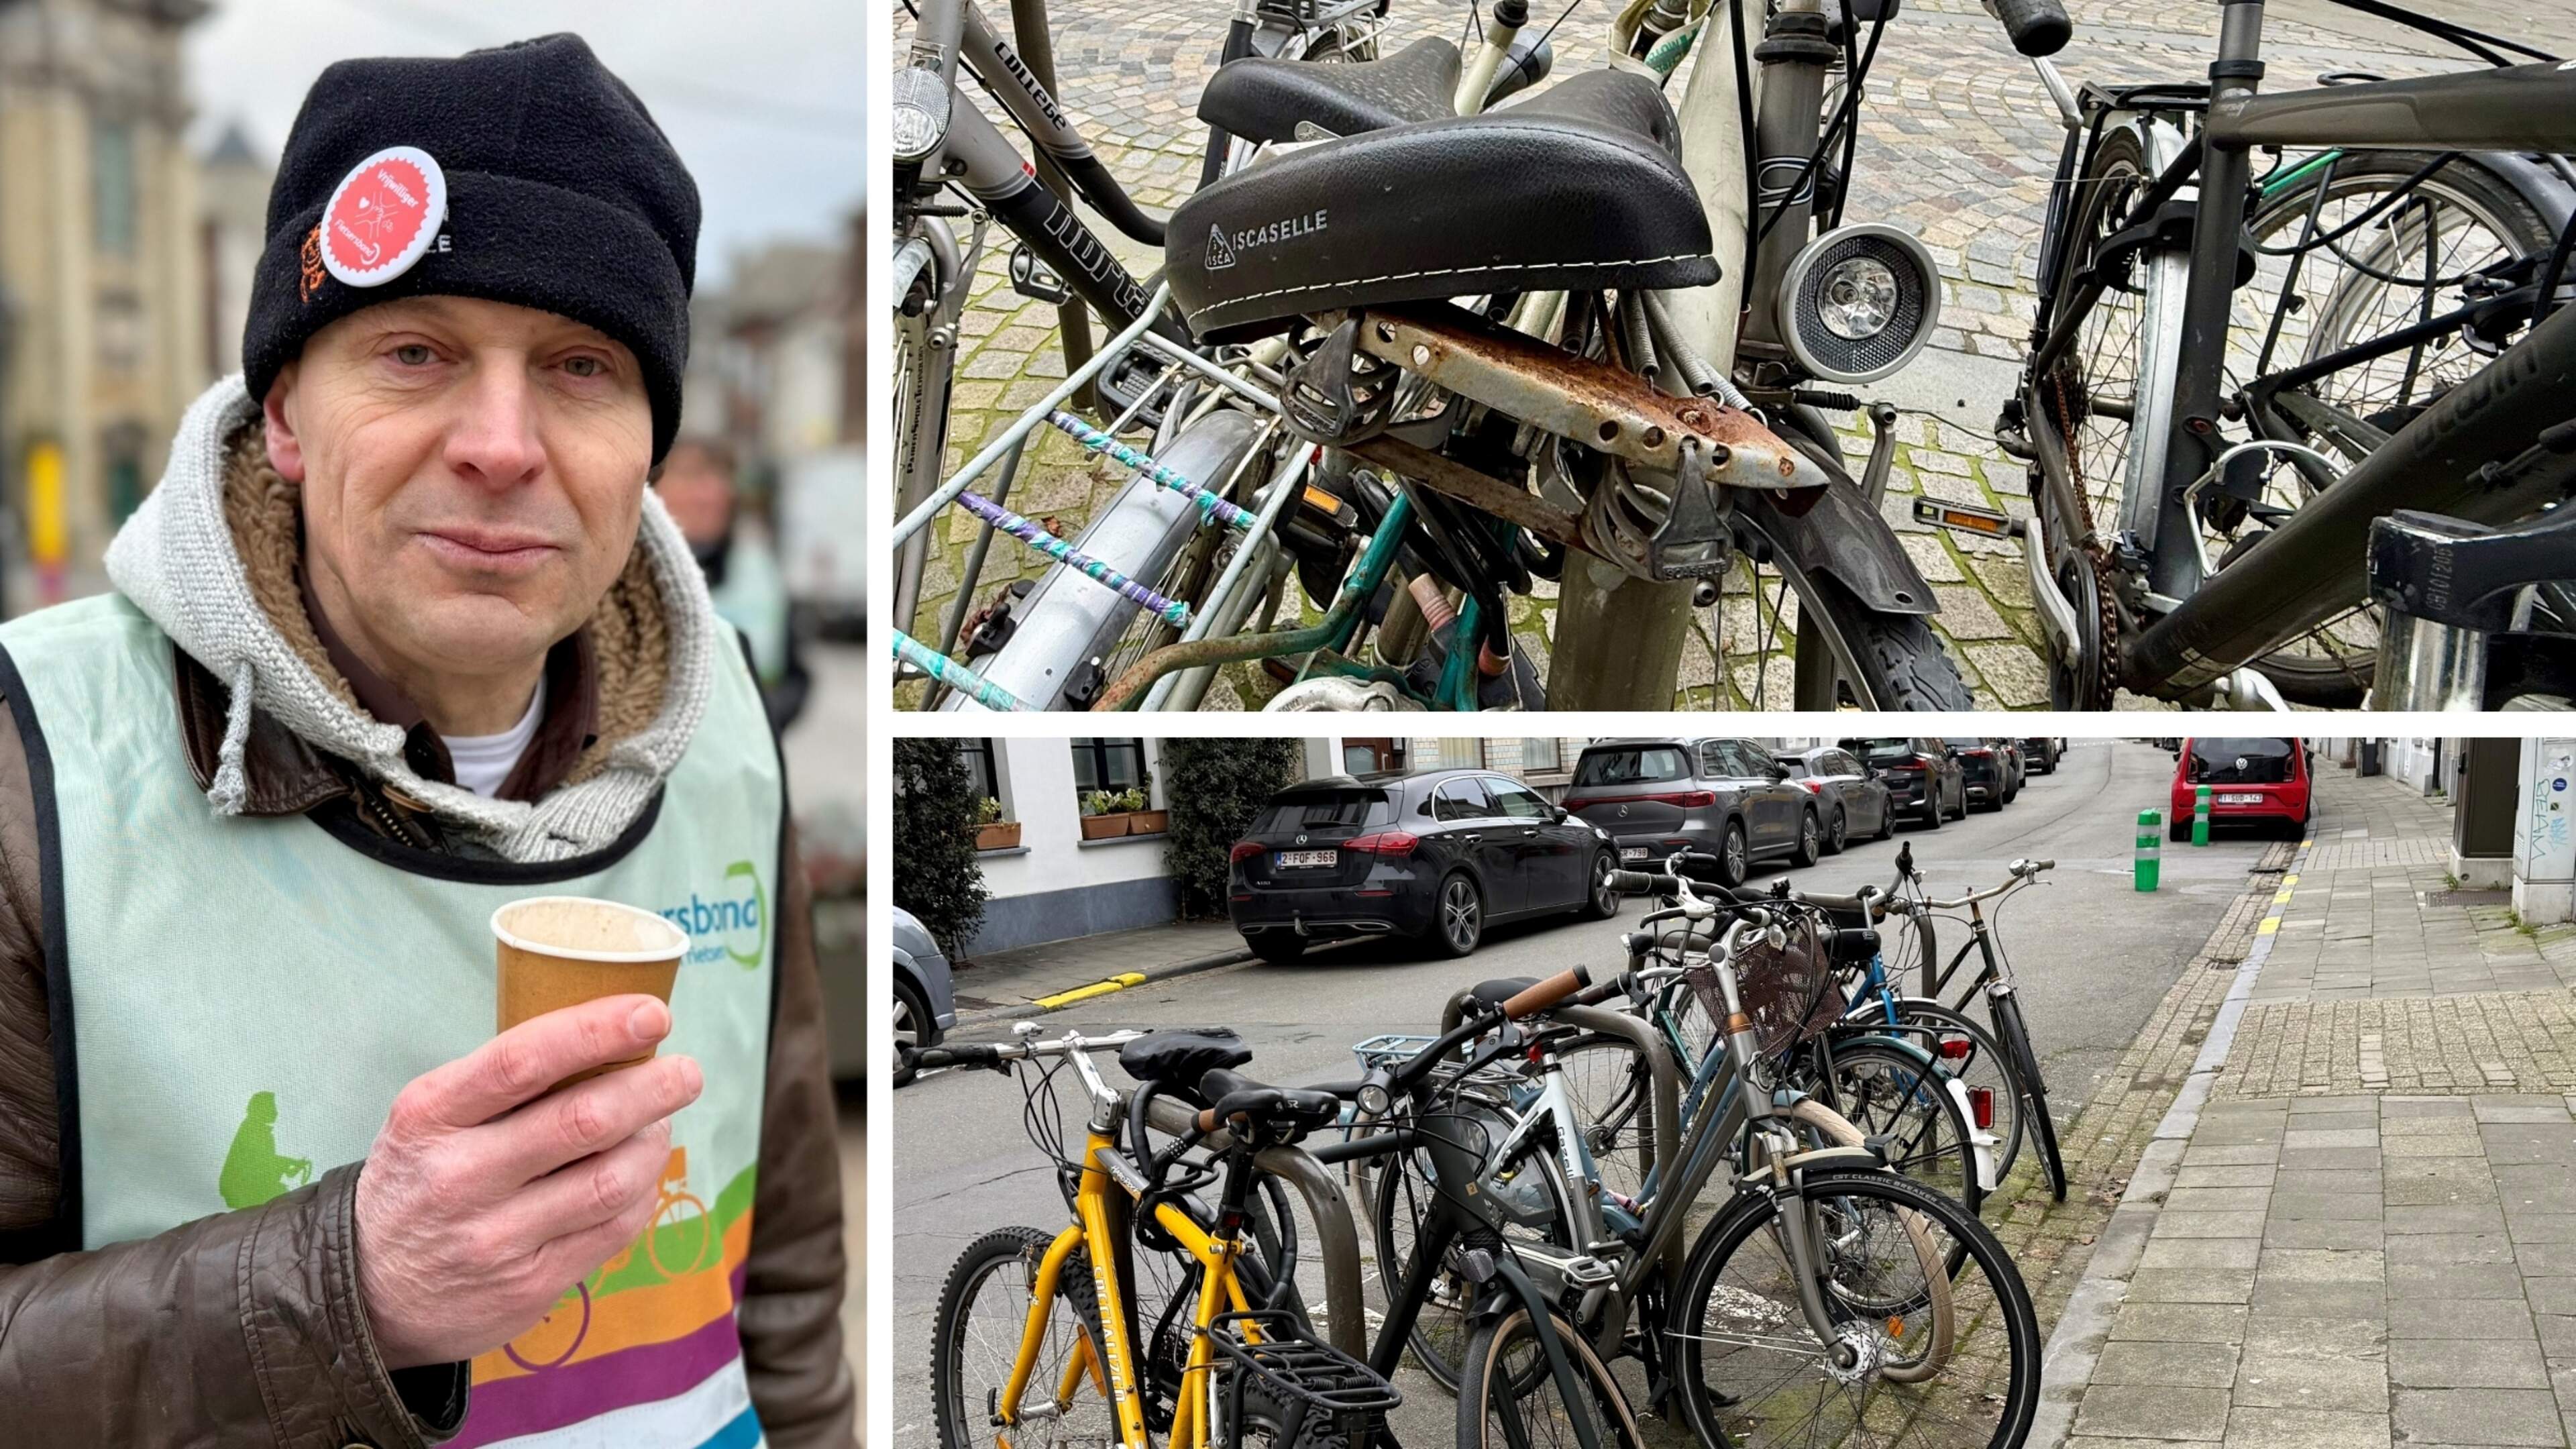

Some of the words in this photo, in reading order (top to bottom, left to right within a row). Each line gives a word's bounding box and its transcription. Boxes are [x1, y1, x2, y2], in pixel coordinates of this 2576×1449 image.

[377, 168, 419, 209] Vrijwilliger
[334, 219, 376, 257] Fietsersbond
[1232, 209, 1328, 251] ISCASELLE
[1556, 1126, 1574, 1189] Gazelle
[1851, 1173, 1891, 1184] CLASSIC
[1893, 1179, 1937, 1203] BREAKER
